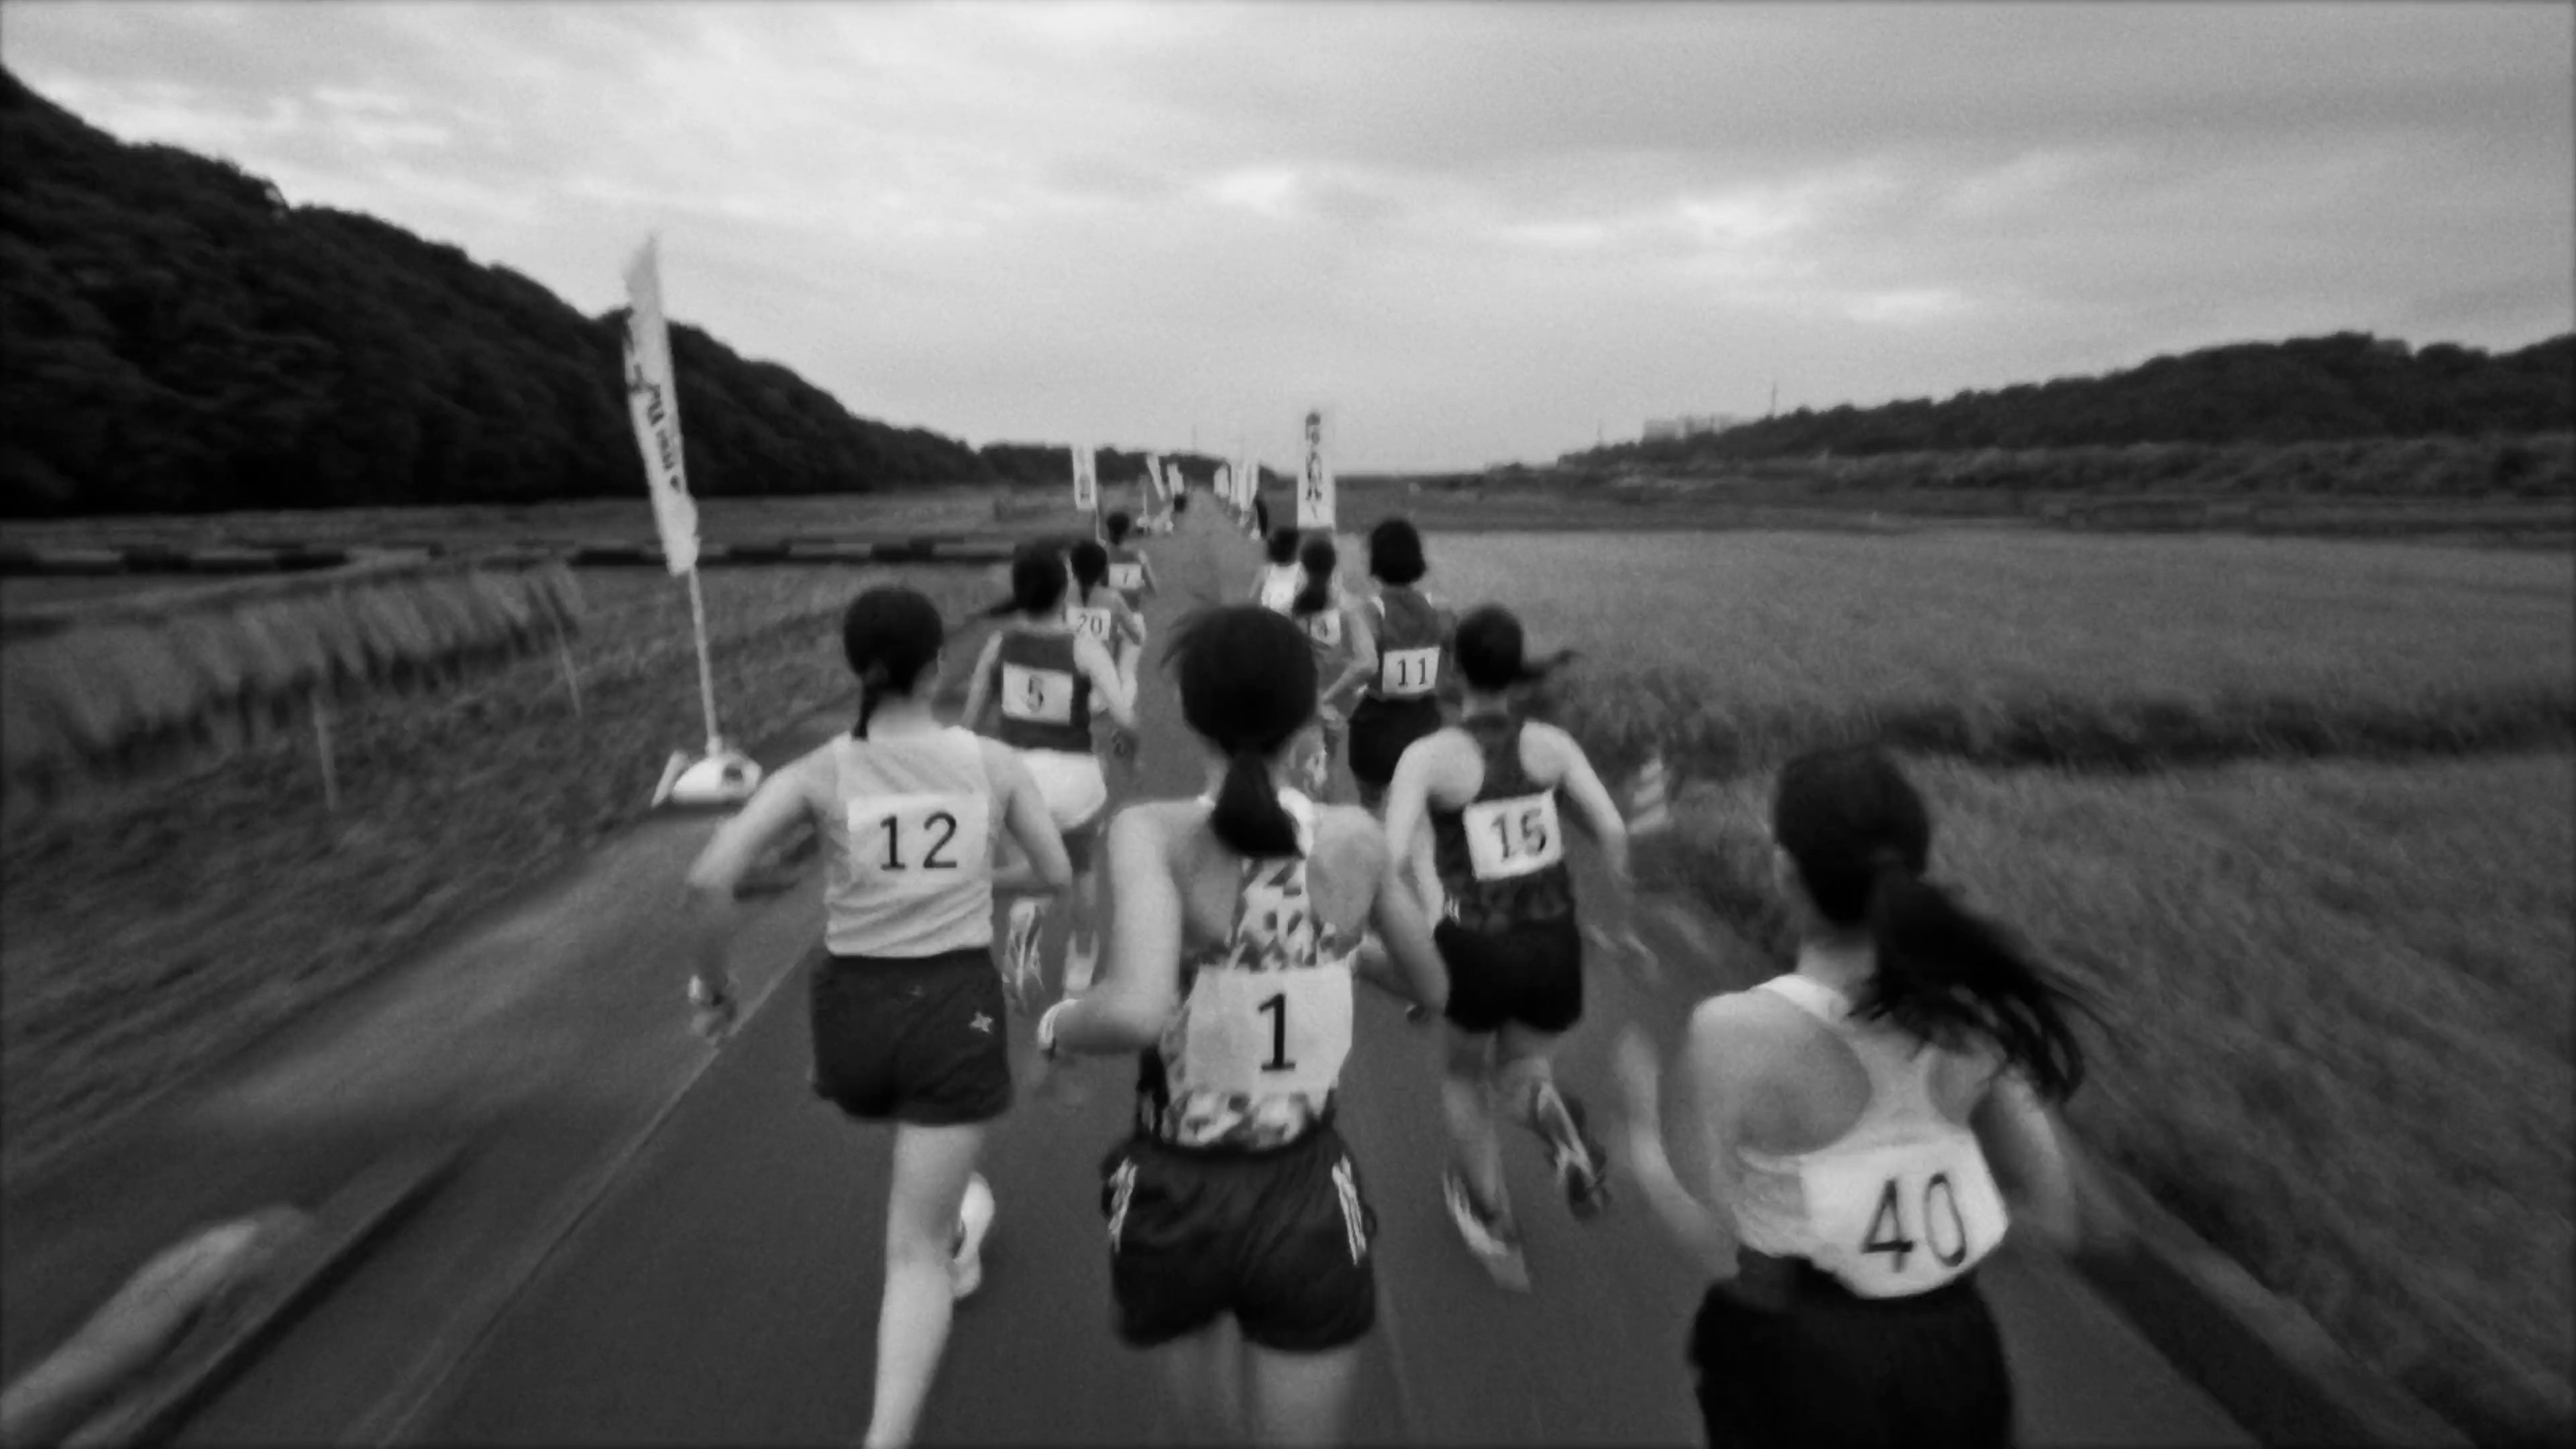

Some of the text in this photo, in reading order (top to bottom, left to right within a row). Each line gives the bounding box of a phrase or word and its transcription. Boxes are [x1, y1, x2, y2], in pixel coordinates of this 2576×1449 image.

[1397, 656, 1428, 687] 11
[879, 812, 957, 871] 12
[1491, 808, 1547, 863] 15
[1258, 992, 1296, 1072] 1
[1860, 1171, 1967, 1274] 40
